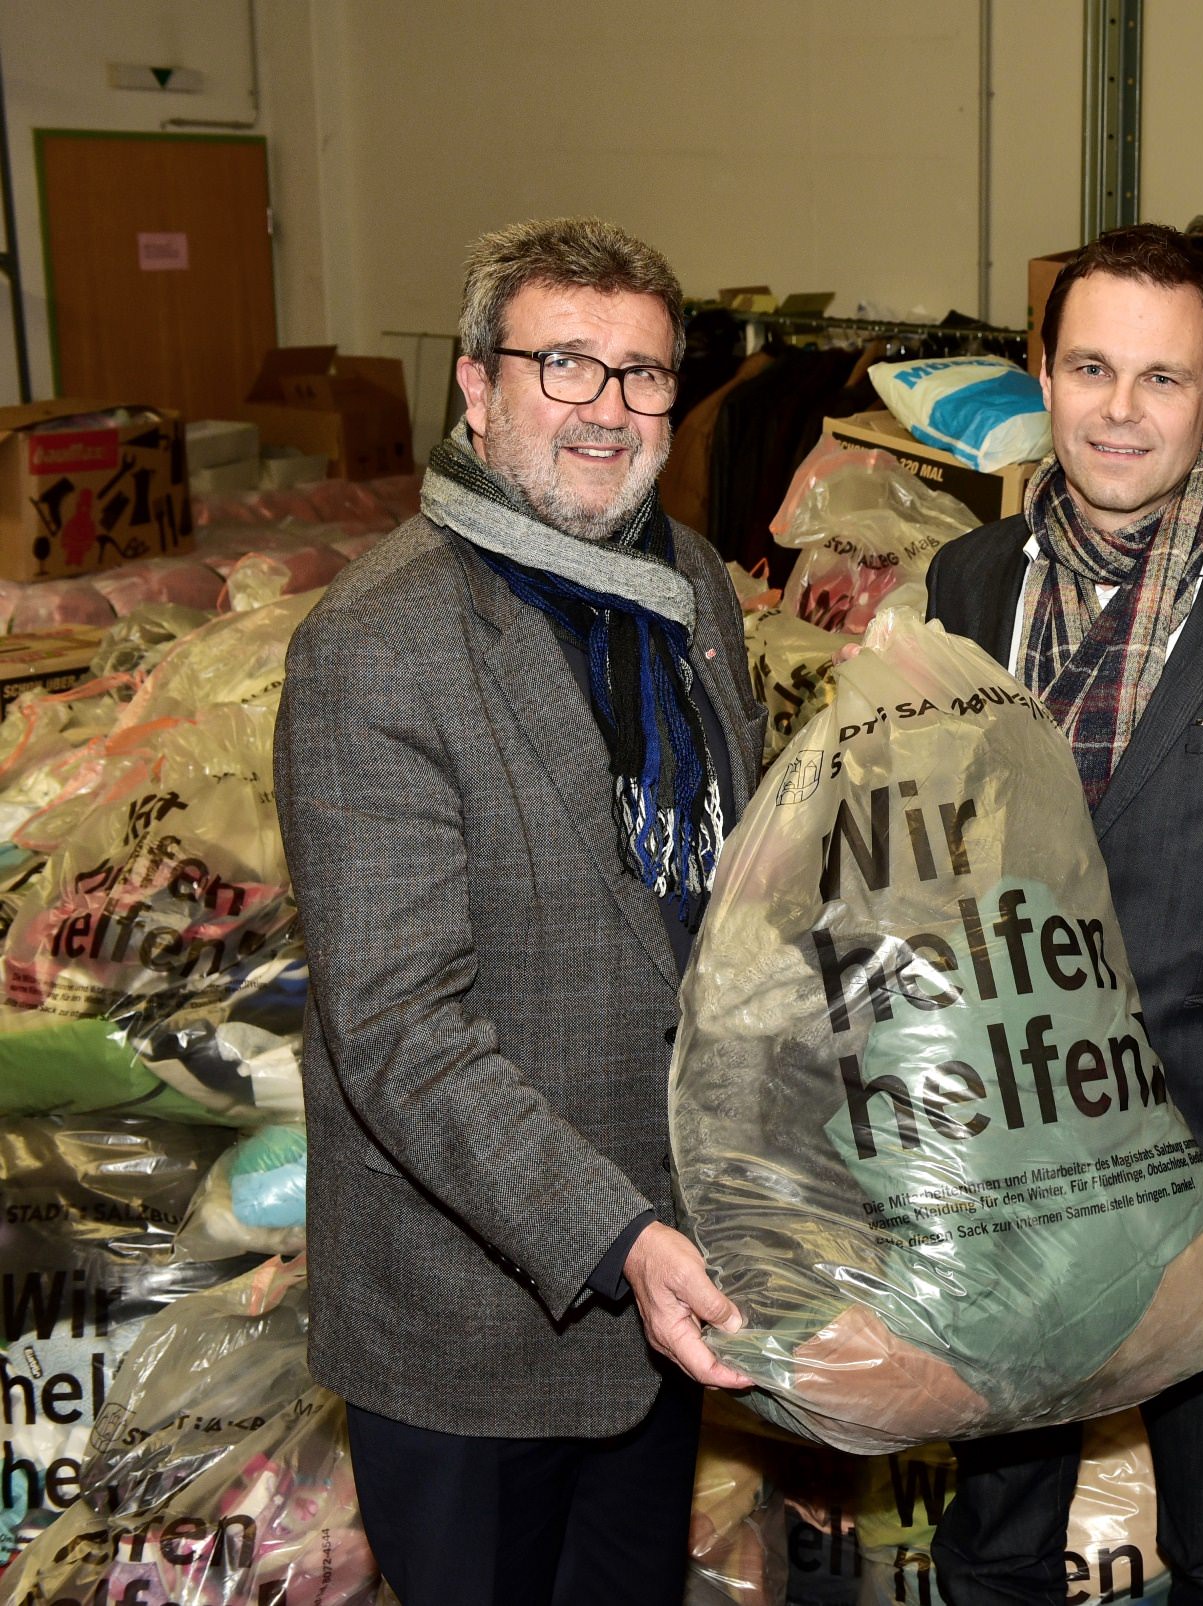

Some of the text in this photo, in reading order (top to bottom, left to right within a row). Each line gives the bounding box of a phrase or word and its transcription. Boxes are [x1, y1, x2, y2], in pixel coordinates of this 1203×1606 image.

[920, 463, 944, 481] MAL
[811, 889, 1118, 1034] helfen
[94, 1203, 183, 1225] SALZBU
[863, 1201, 885, 1216] Die
[888, 1178, 1001, 1210] Mitbeiterinnen
[1004, 1171, 1028, 1188] und
[1031, 1160, 1092, 1184] Mitarbeiter
[1095, 1157, 1111, 1172] des
[1111, 1148, 1155, 1169] Magistrats
[1154, 1141, 1184, 1158] Salzburg
[869, 1214, 911, 1231] warme
[914, 1201, 977, 1221] Kleidung
[979, 1195, 998, 1209] für
[1002, 1192, 1025, 1206] den
[1027, 1184, 1067, 1202] Winter.
[1070, 1179, 1089, 1194] Für
[1092, 1168, 1146, 1190] Flüchtlinge,
[1147, 1154, 1190, 1177] Obdachlose,
[908, 1230, 953, 1248] diesen
[957, 1222, 989, 1239] Sack
[992, 1220, 1012, 1233] zur
[1016, 1210, 1063, 1230] internen
[1065, 1194, 1135, 1220] Sammelstelle
[1136, 1186, 1171, 1204] bringen.
[1171, 1177, 1196, 1195] Danke!
[2, 1269, 122, 1342] Wir
